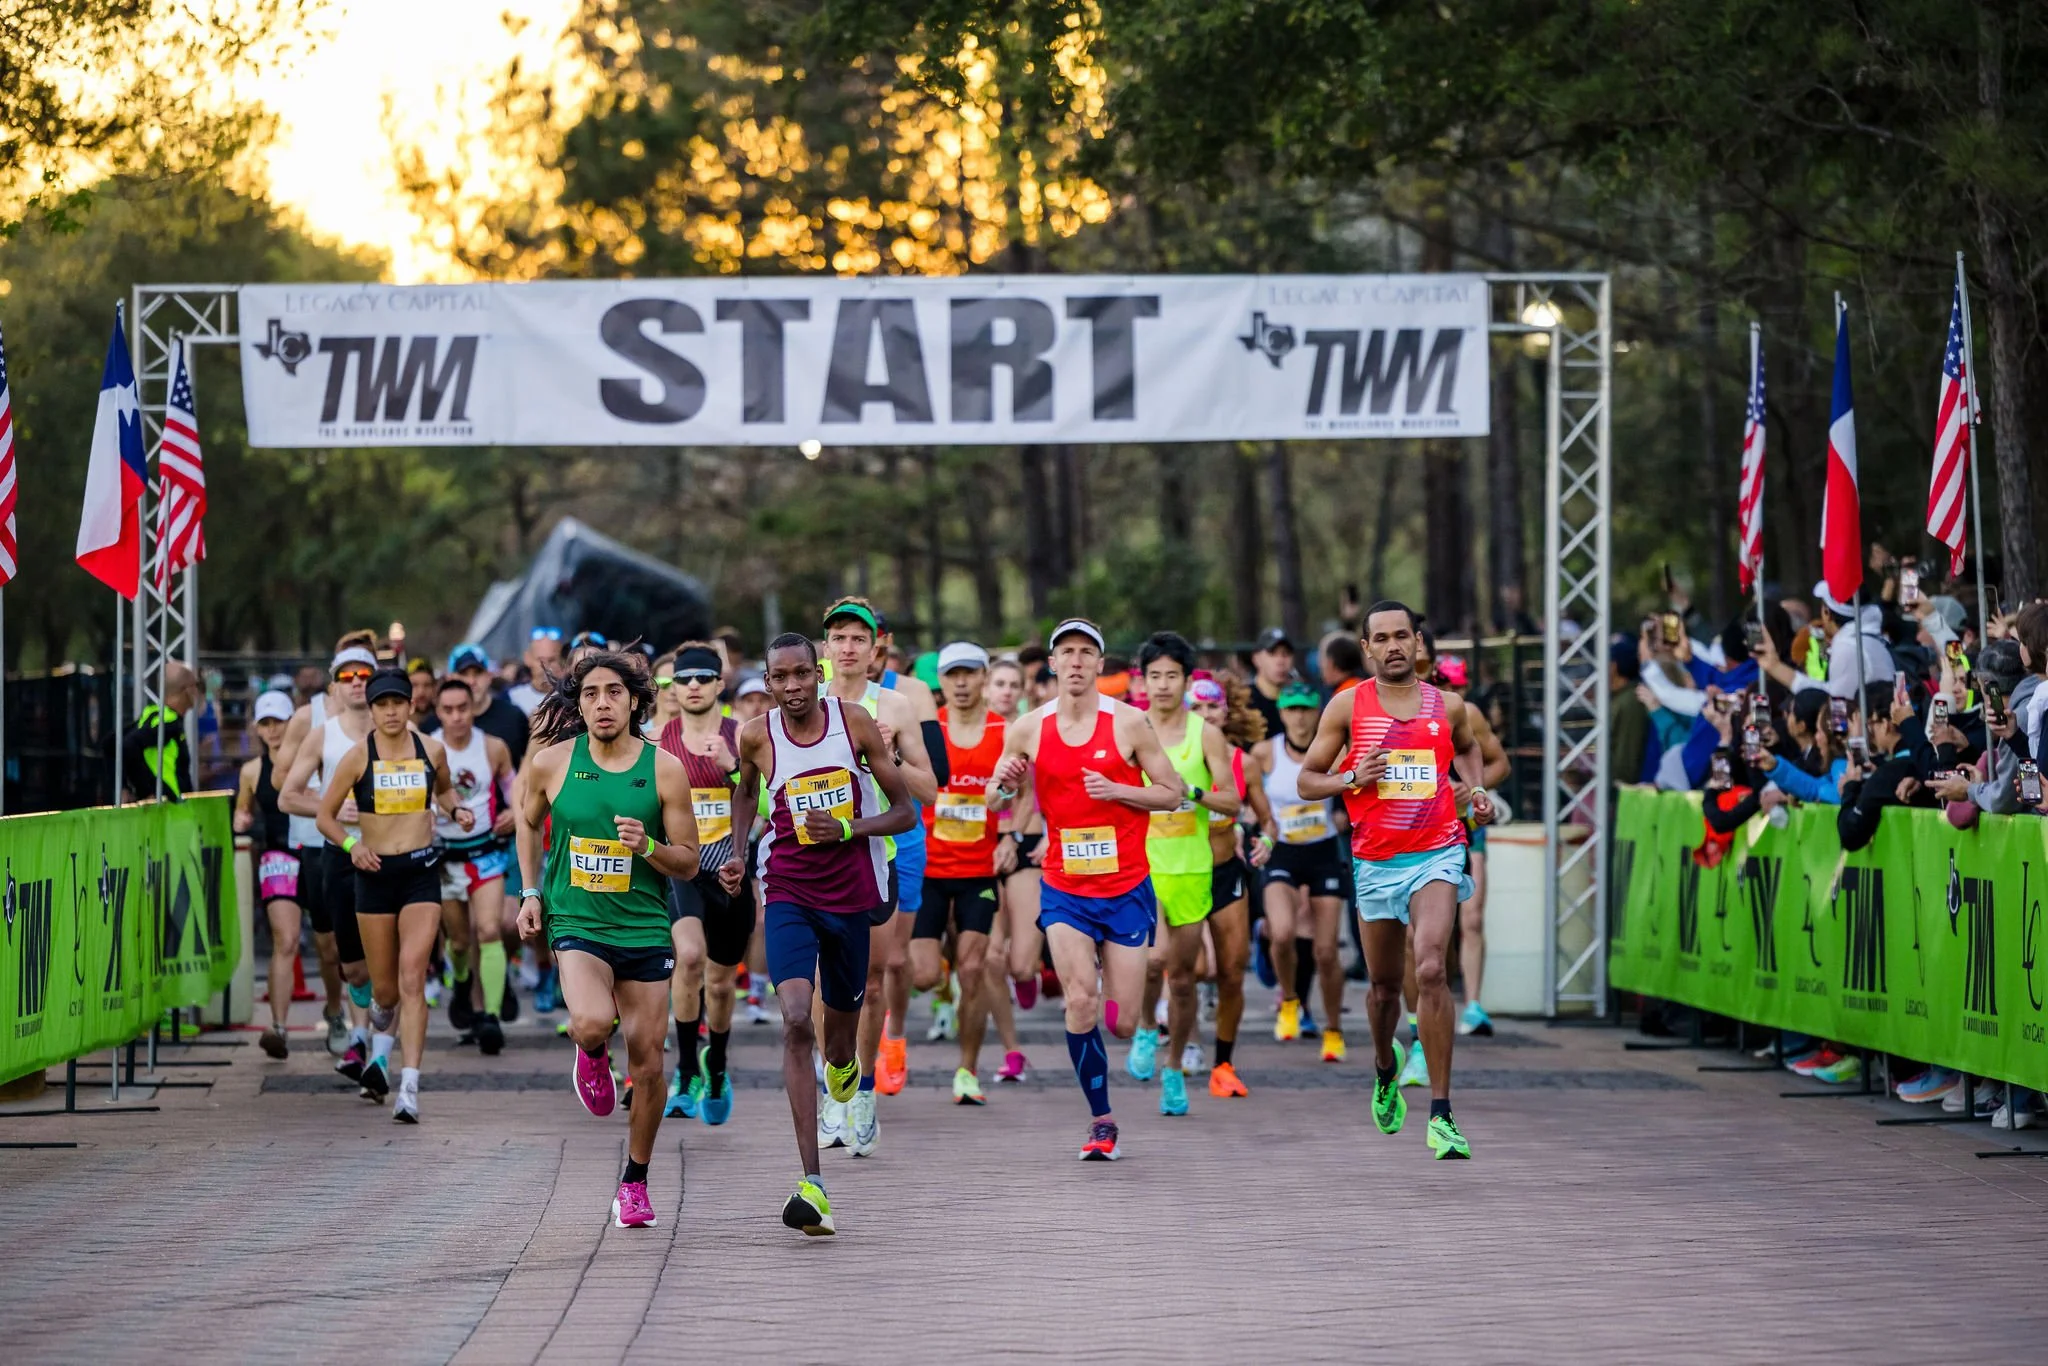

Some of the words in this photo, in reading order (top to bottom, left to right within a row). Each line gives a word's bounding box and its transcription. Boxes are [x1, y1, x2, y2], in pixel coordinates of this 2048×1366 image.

[285, 293, 383, 313] LEGACY
[387, 291, 490, 313] CAPITAL
[598, 296, 1161, 425] START
[317, 335, 479, 423] TWM
[1304, 328, 1466, 416] TWM
[380, 774, 421, 787] ELITE
[1383, 766, 1430, 780] ELITE
[813, 779, 829, 791] TWM
[1400, 782, 1413, 792] 26
[796, 787, 847, 812] ELITE
[592, 844, 610, 855] TWM
[1067, 842, 1111, 857] ELITE
[575, 854, 625, 873] ELITE
[589, 873, 604, 884] 22
